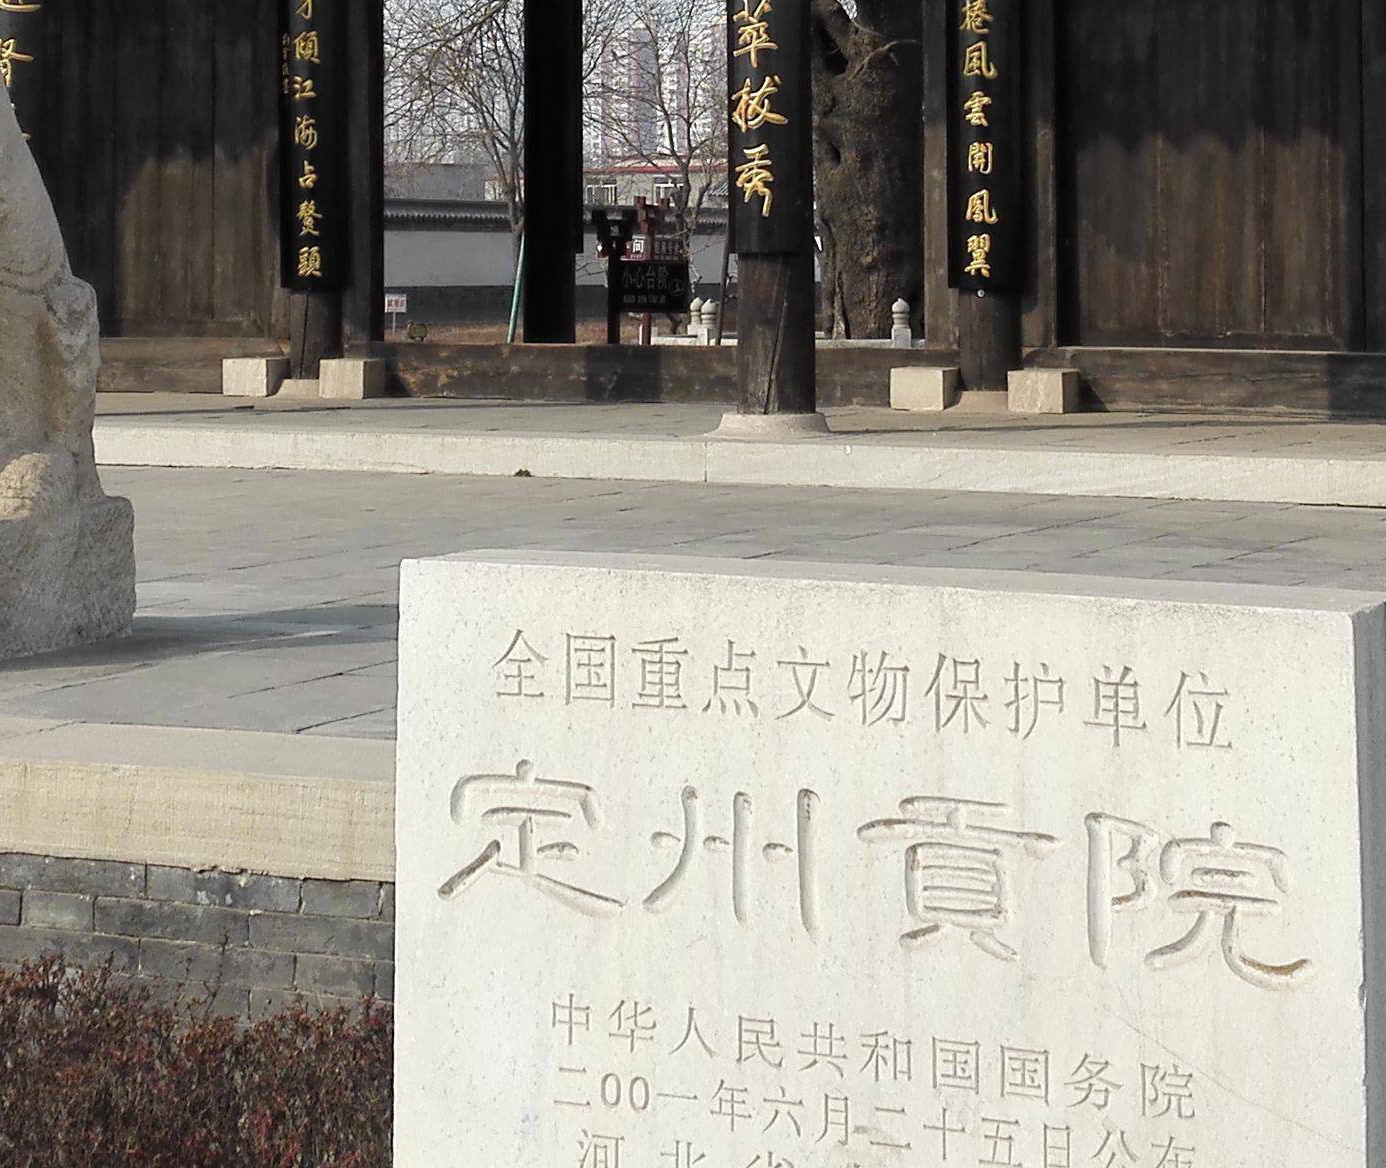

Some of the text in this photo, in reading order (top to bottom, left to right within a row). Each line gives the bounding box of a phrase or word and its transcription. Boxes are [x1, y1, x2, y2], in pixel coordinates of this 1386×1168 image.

[491, 627, 1235, 752] 全国重点文物保护单位
[550, 992, 1197, 1121] 中华人民共和国国务院
